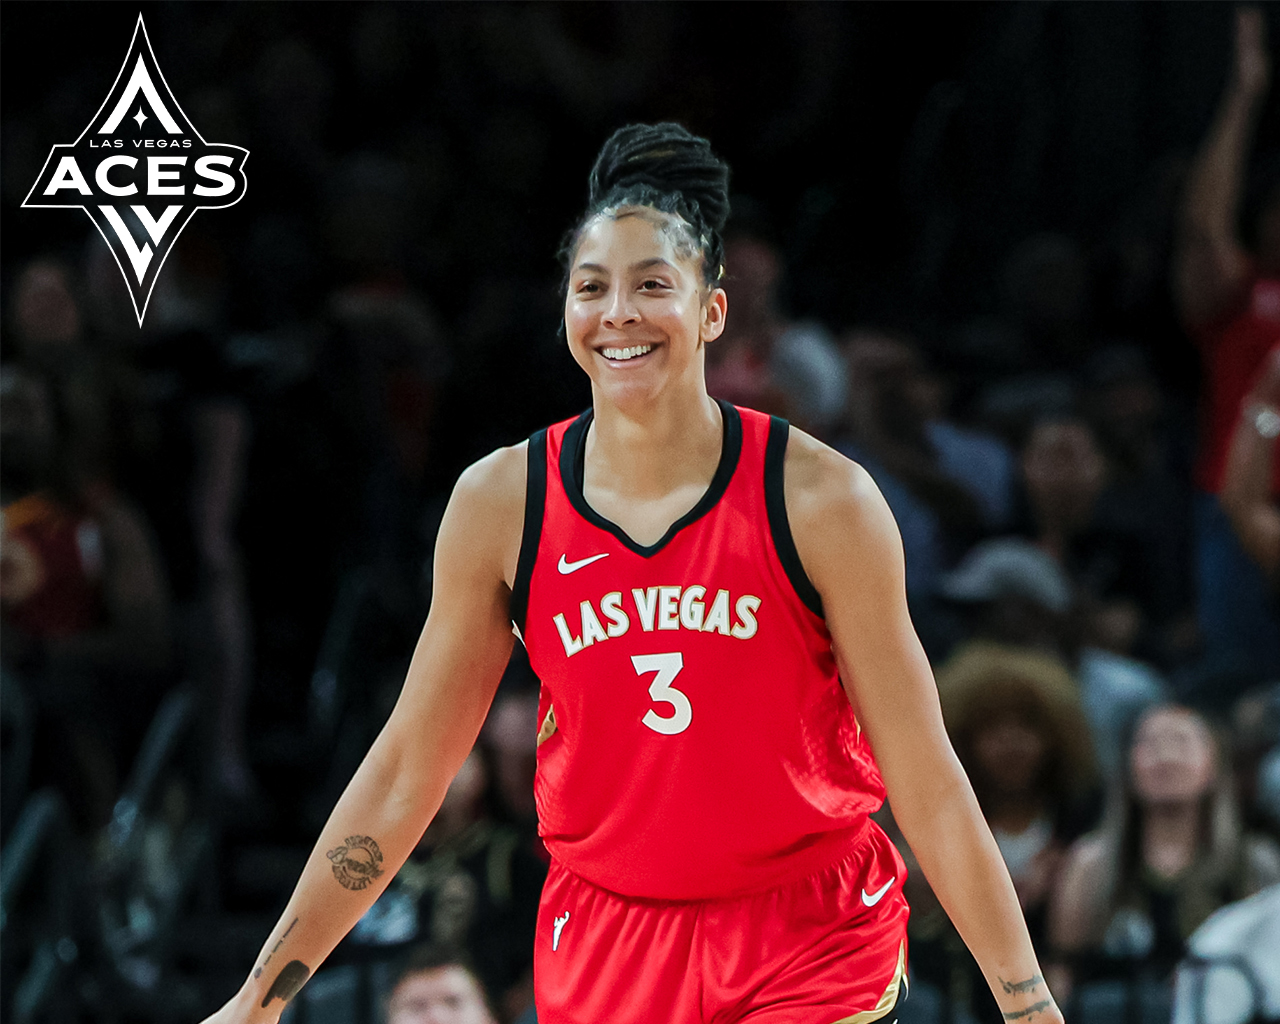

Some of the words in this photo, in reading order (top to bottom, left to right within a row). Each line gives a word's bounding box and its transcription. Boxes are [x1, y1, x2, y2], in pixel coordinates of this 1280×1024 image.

[552, 591, 630, 658] LAS
[631, 584, 762, 640] VEGAS
[630, 651, 693, 735] 3
